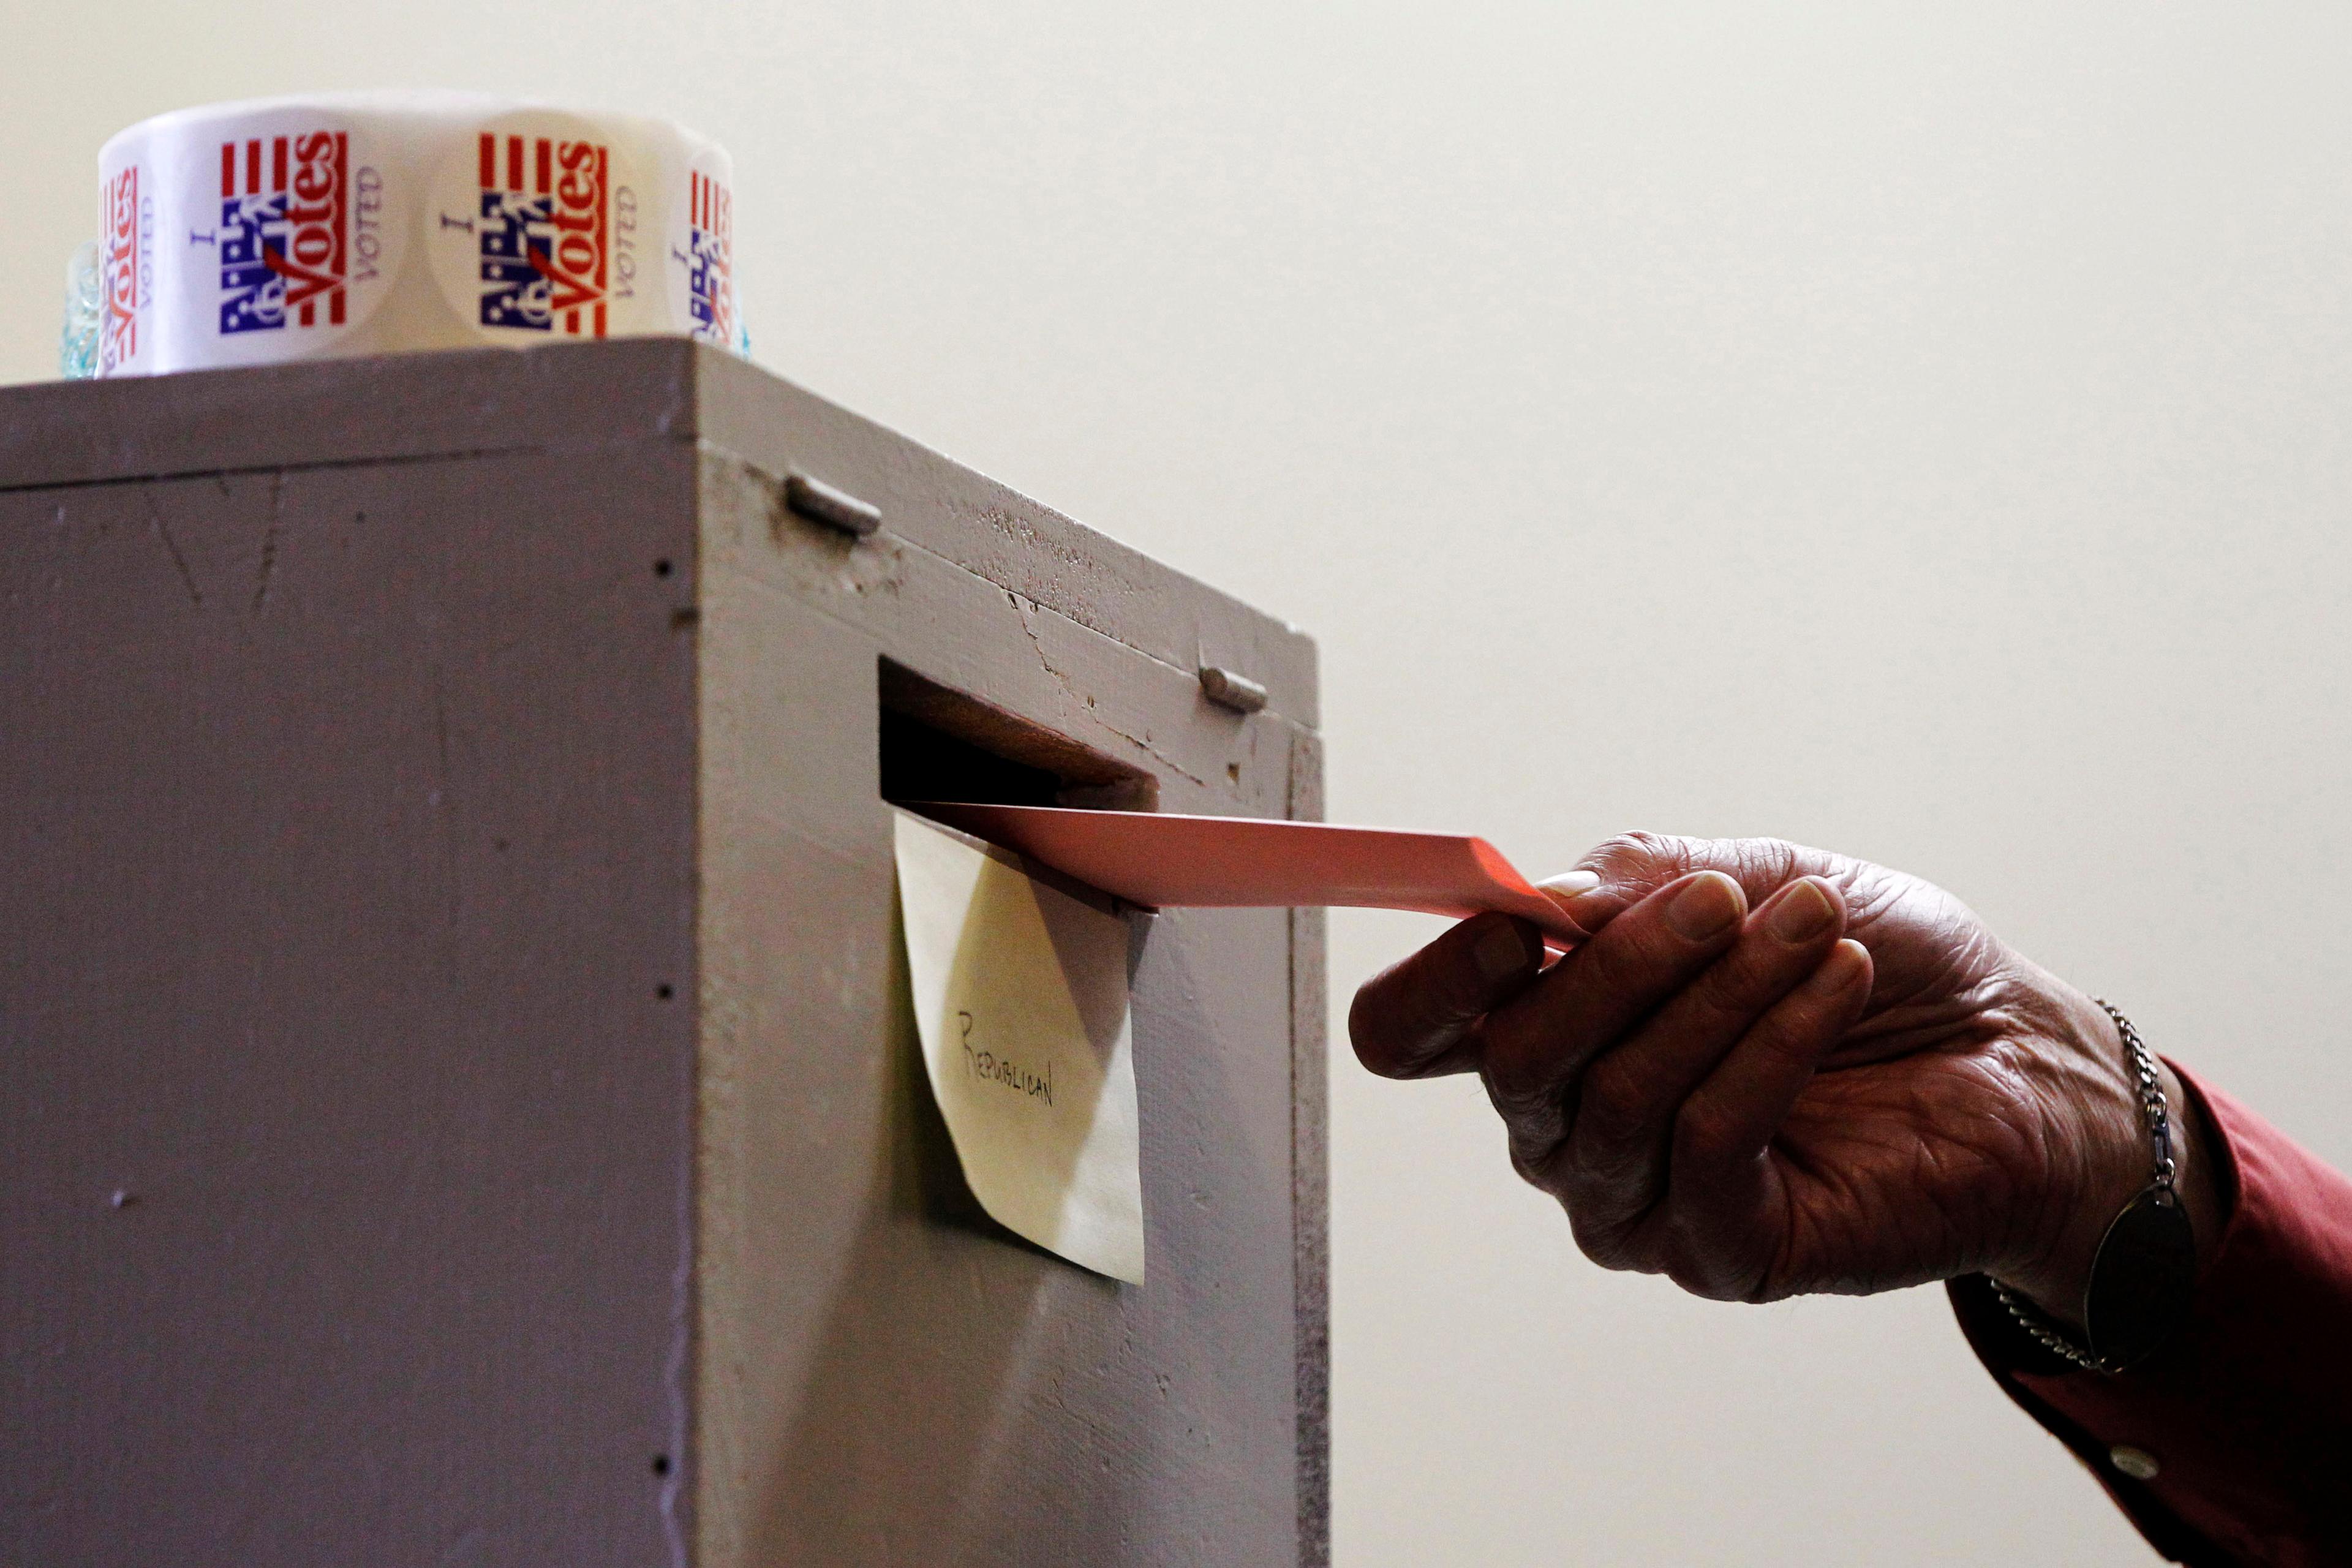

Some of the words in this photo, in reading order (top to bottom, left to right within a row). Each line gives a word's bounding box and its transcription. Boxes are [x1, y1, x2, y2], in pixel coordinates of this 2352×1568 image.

[108, 168, 134, 341] Votes
[140, 197, 153, 311] VOTED
[190, 229, 216, 246] I
[264, 130, 342, 306] Votes
[354, 165, 383, 284] VOTED
[440, 213, 474, 234] I
[526, 140, 603, 310] Votes
[614, 184, 638, 299] VOTED
[959, 1011, 1052, 1107] REPUBLICAN
